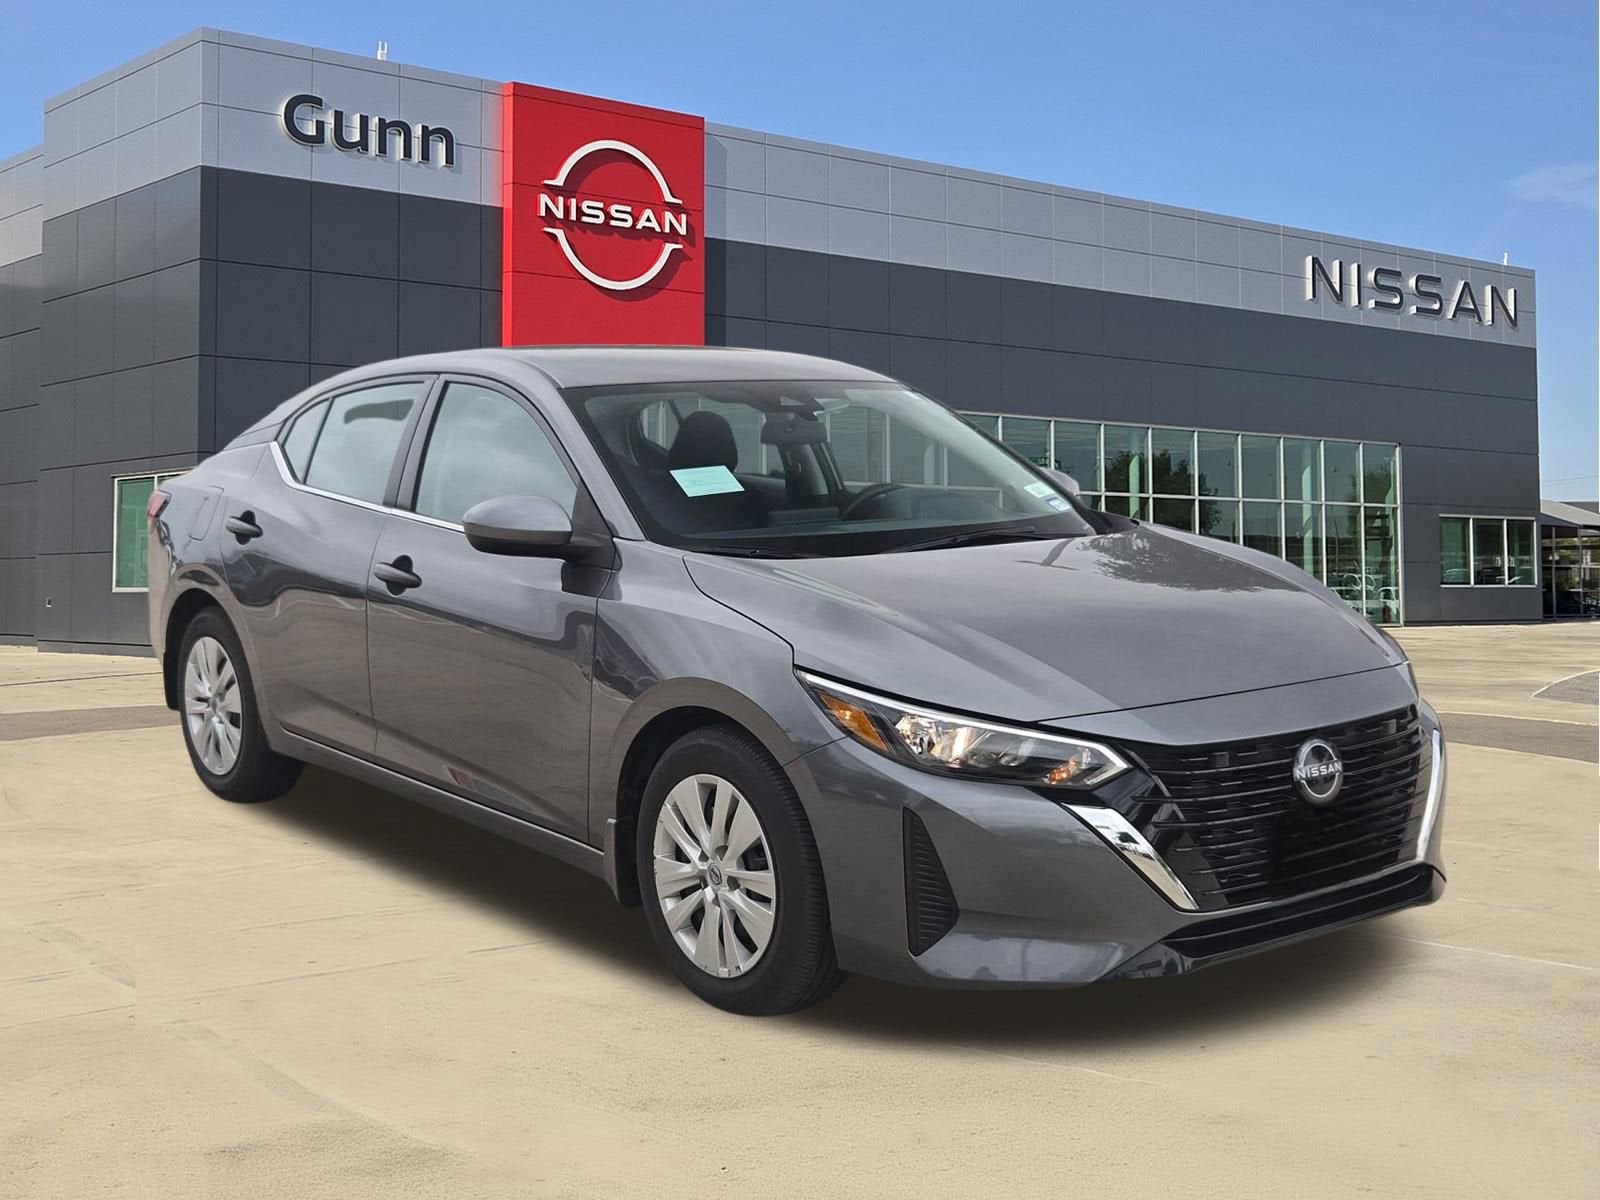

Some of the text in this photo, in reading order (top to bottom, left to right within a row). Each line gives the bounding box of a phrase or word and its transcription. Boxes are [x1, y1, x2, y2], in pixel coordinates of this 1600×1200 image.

[282, 93, 455, 167] Gunn
[538, 193, 687, 235] NISSAN
[1305, 255, 1518, 327] NISSAN
[1296, 763, 1342, 779] NISSAN
